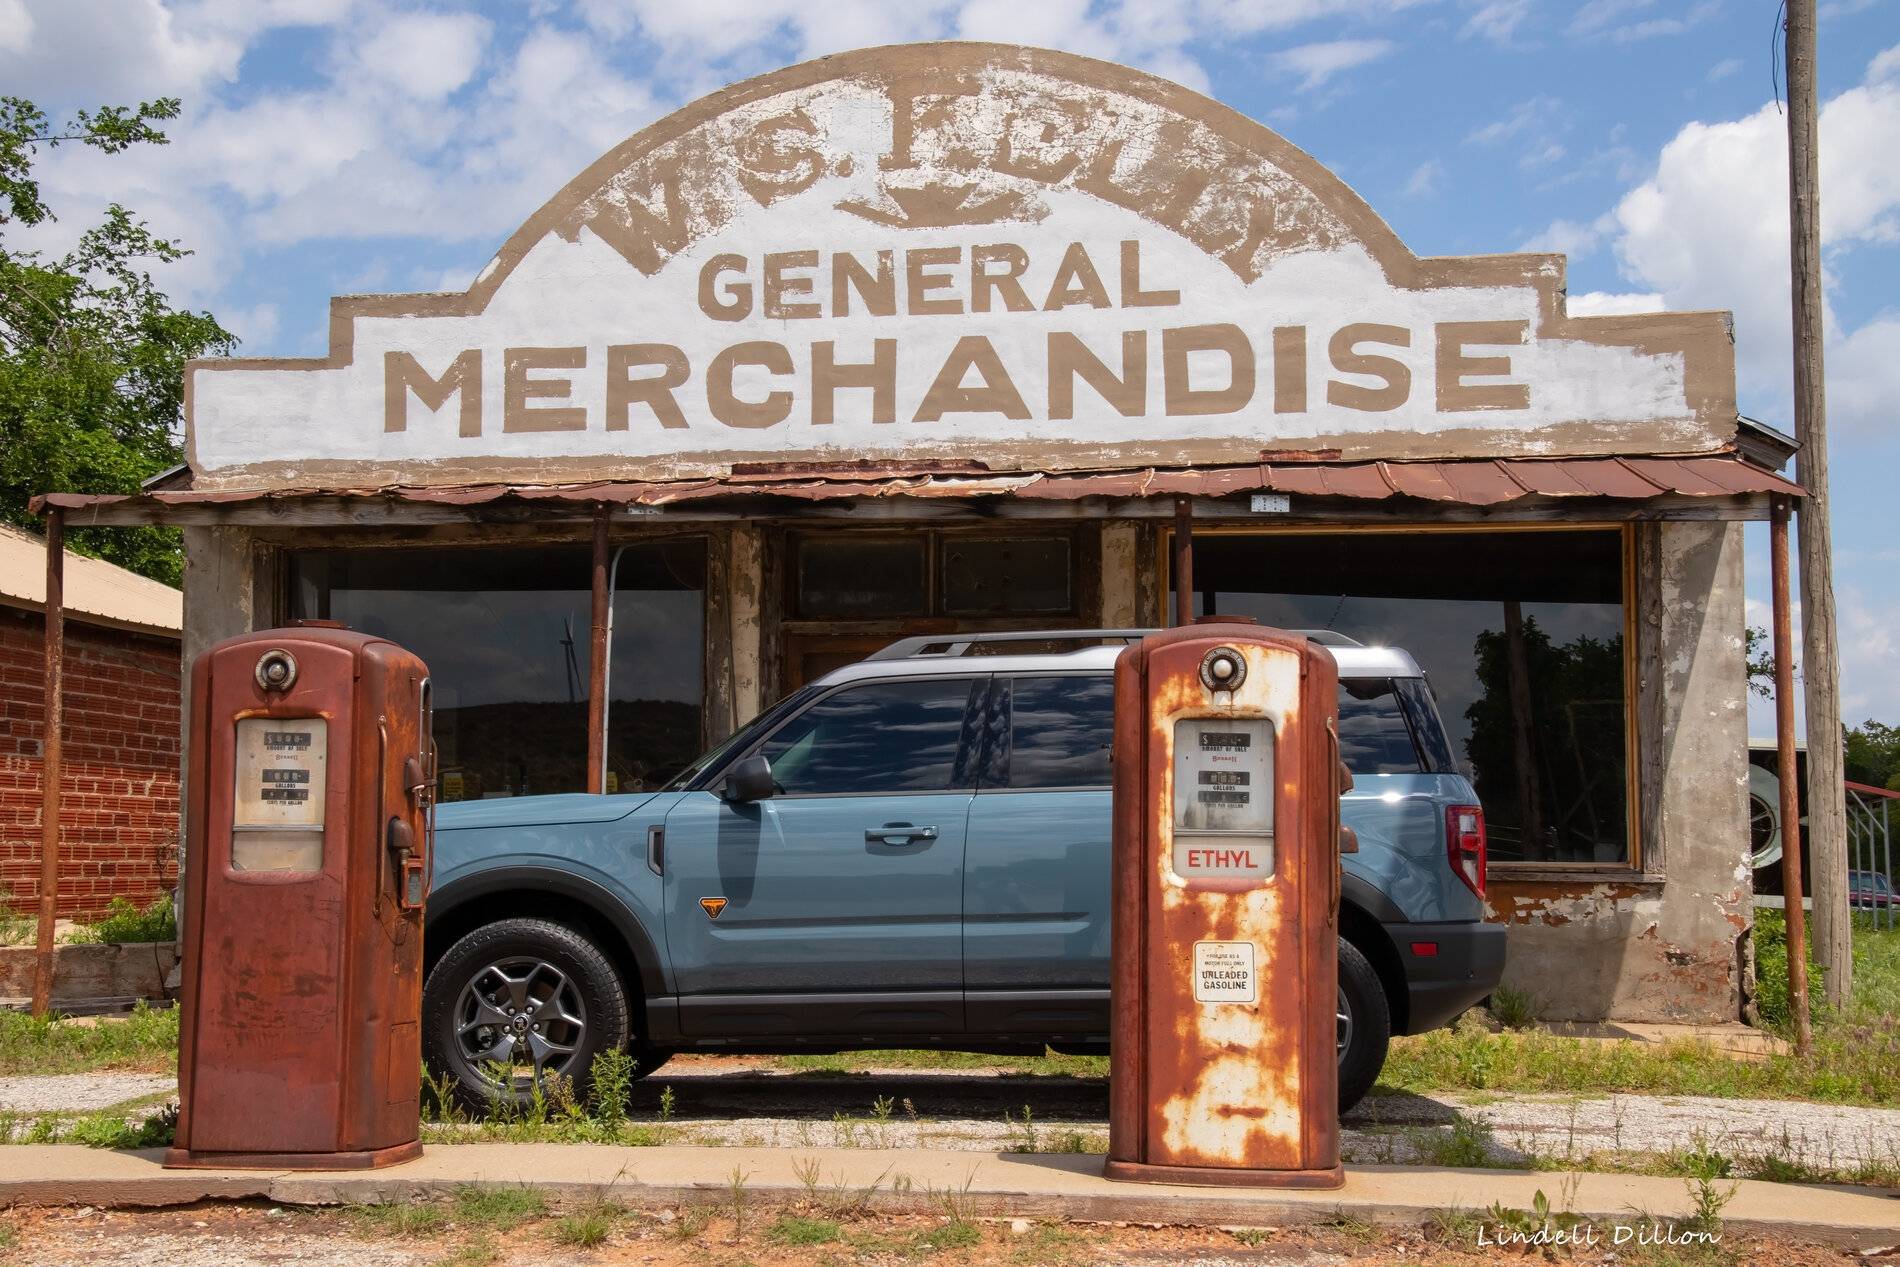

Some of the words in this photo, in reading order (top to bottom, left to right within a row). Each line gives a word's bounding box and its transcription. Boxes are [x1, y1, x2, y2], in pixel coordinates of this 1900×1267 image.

[697, 239, 1181, 323] GENERAL
[384, 319, 1531, 439] MERCHANDISE
[1188, 849, 1258, 869] ETHYL
[1202, 970, 1248, 980] UNLEADED
[1203, 981, 1247, 990] GASOLINE
